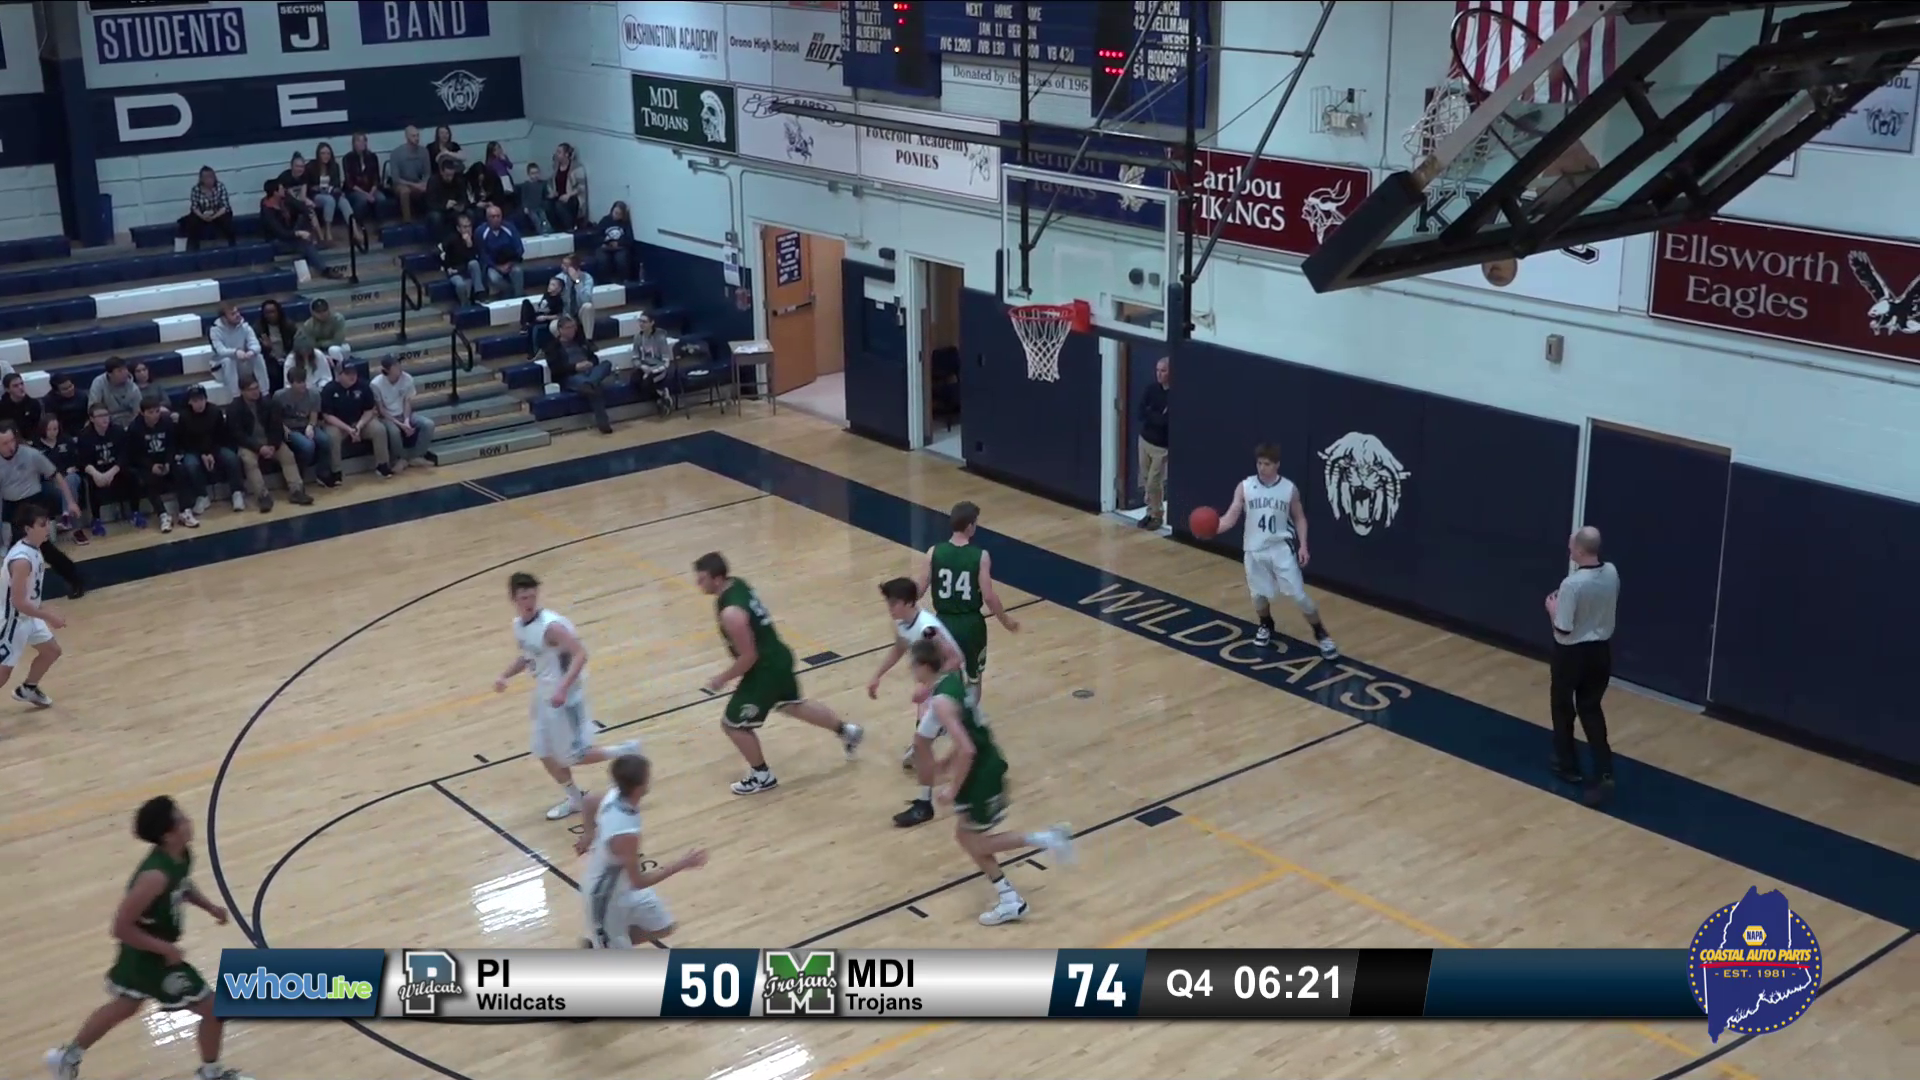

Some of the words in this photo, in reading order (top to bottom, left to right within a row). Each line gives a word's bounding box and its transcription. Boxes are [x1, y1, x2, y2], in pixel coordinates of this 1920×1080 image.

[280, 4, 324, 15] SECTION
[965, 2, 983, 17] NEXT
[994, 4, 1013, 19] HOME
[1027, 6, 1042, 21] AME
[384, 1, 467, 40] BAND
[978, 22, 992, 36] JAN
[1133, 15, 1146, 31] 42
[100, 11, 241, 60] STUDENTS
[289, 17, 320, 48] J
[624, 20, 677, 50] WASHINGTON
[679, 27, 719, 53] ACADEMY
[754, 37, 773, 52] High
[772, 40, 800, 54] School
[953, 38, 972, 52] 1200
[992, 41, 1006, 56] 130
[952, 65, 992, 82] Donated
[994, 70, 1005, 86] by
[1055, 77, 1067, 90] of
[1133, 63, 1145, 79] 54
[1147, 65, 1178, 83] ISAACS
[649, 86, 679, 110] MDI
[895, 154, 940, 170] PONIES
[1663, 232, 1841, 286] Ellsworth
[1685, 274, 1809, 321] Eagles
[374, 321, 395, 331] ROW
[401, 350, 423, 361] ROW
[424, 380, 447, 391] ROW
[451, 411, 474, 422] ROW
[479, 446, 502, 457] ROW
[1249, 497, 1289, 513] WILDCATS
[1257, 514, 1277, 534] 40
[938, 568, 972, 601] 34
[1078, 583, 1412, 712] WILDCATS
